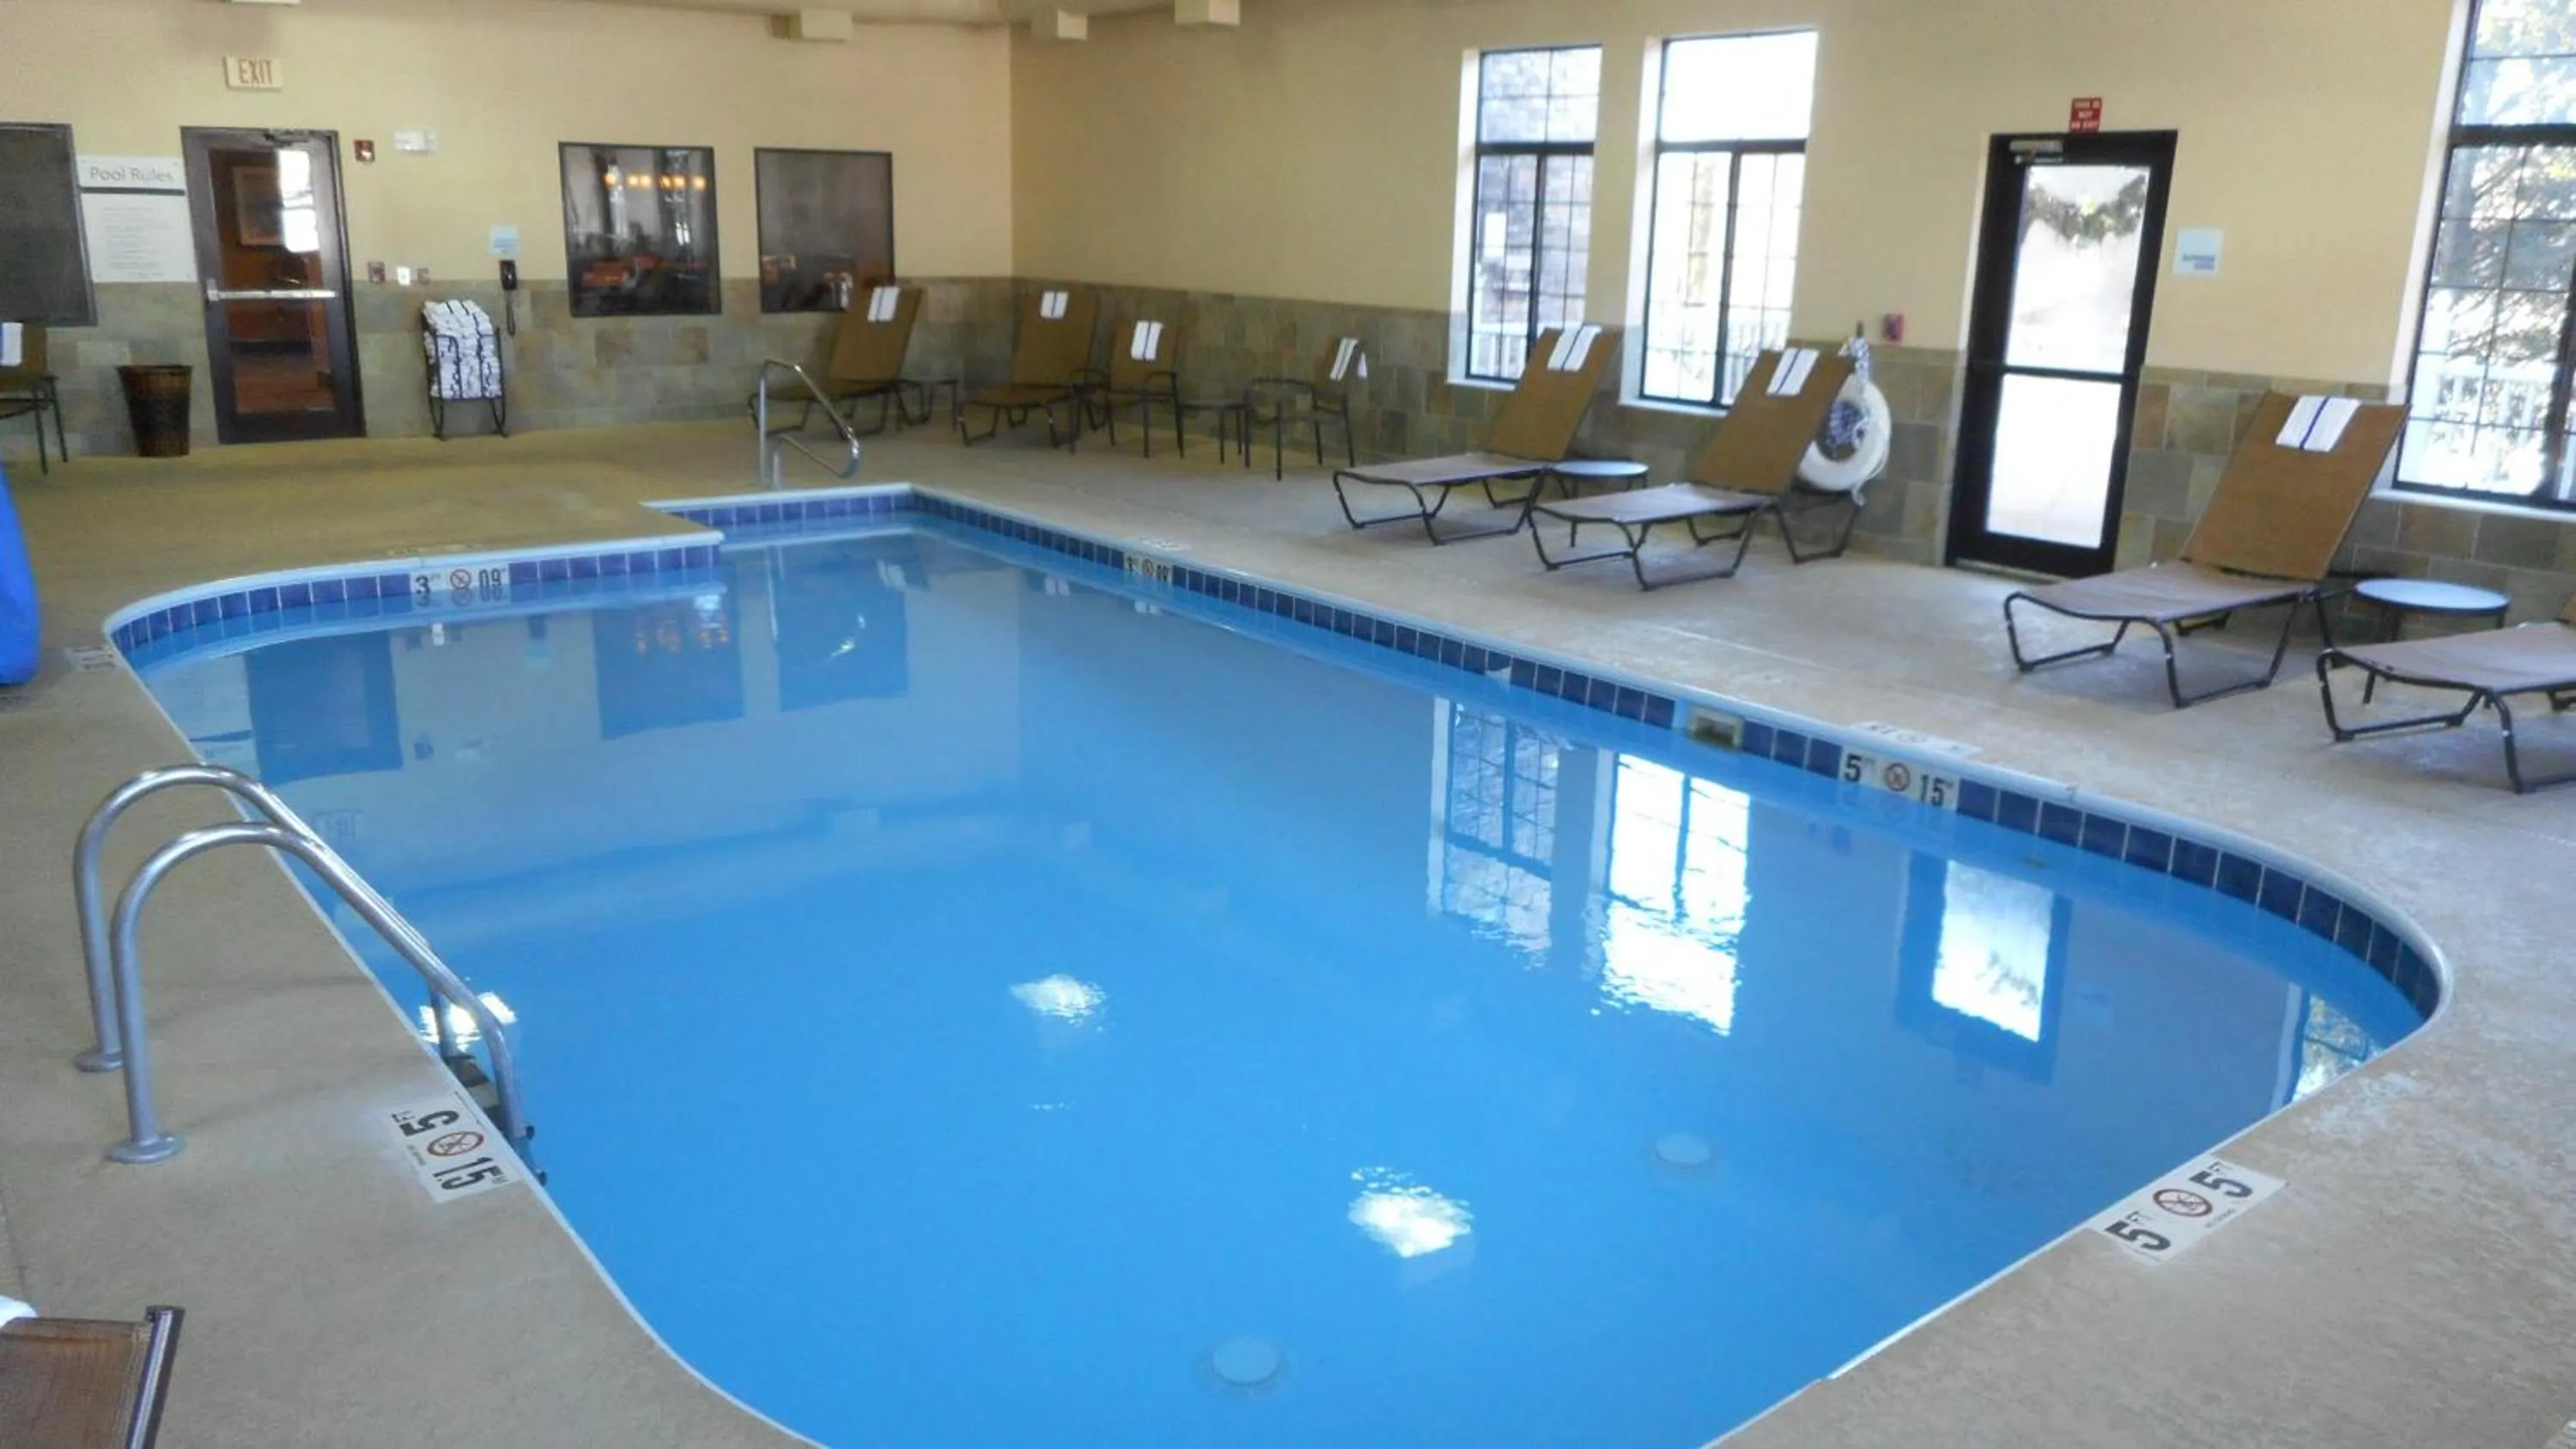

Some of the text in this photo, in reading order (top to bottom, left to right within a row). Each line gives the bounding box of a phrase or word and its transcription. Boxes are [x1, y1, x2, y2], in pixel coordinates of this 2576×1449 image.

[238, 58, 272, 84] EXIT
[90, 167, 174, 183] Pool Rules
